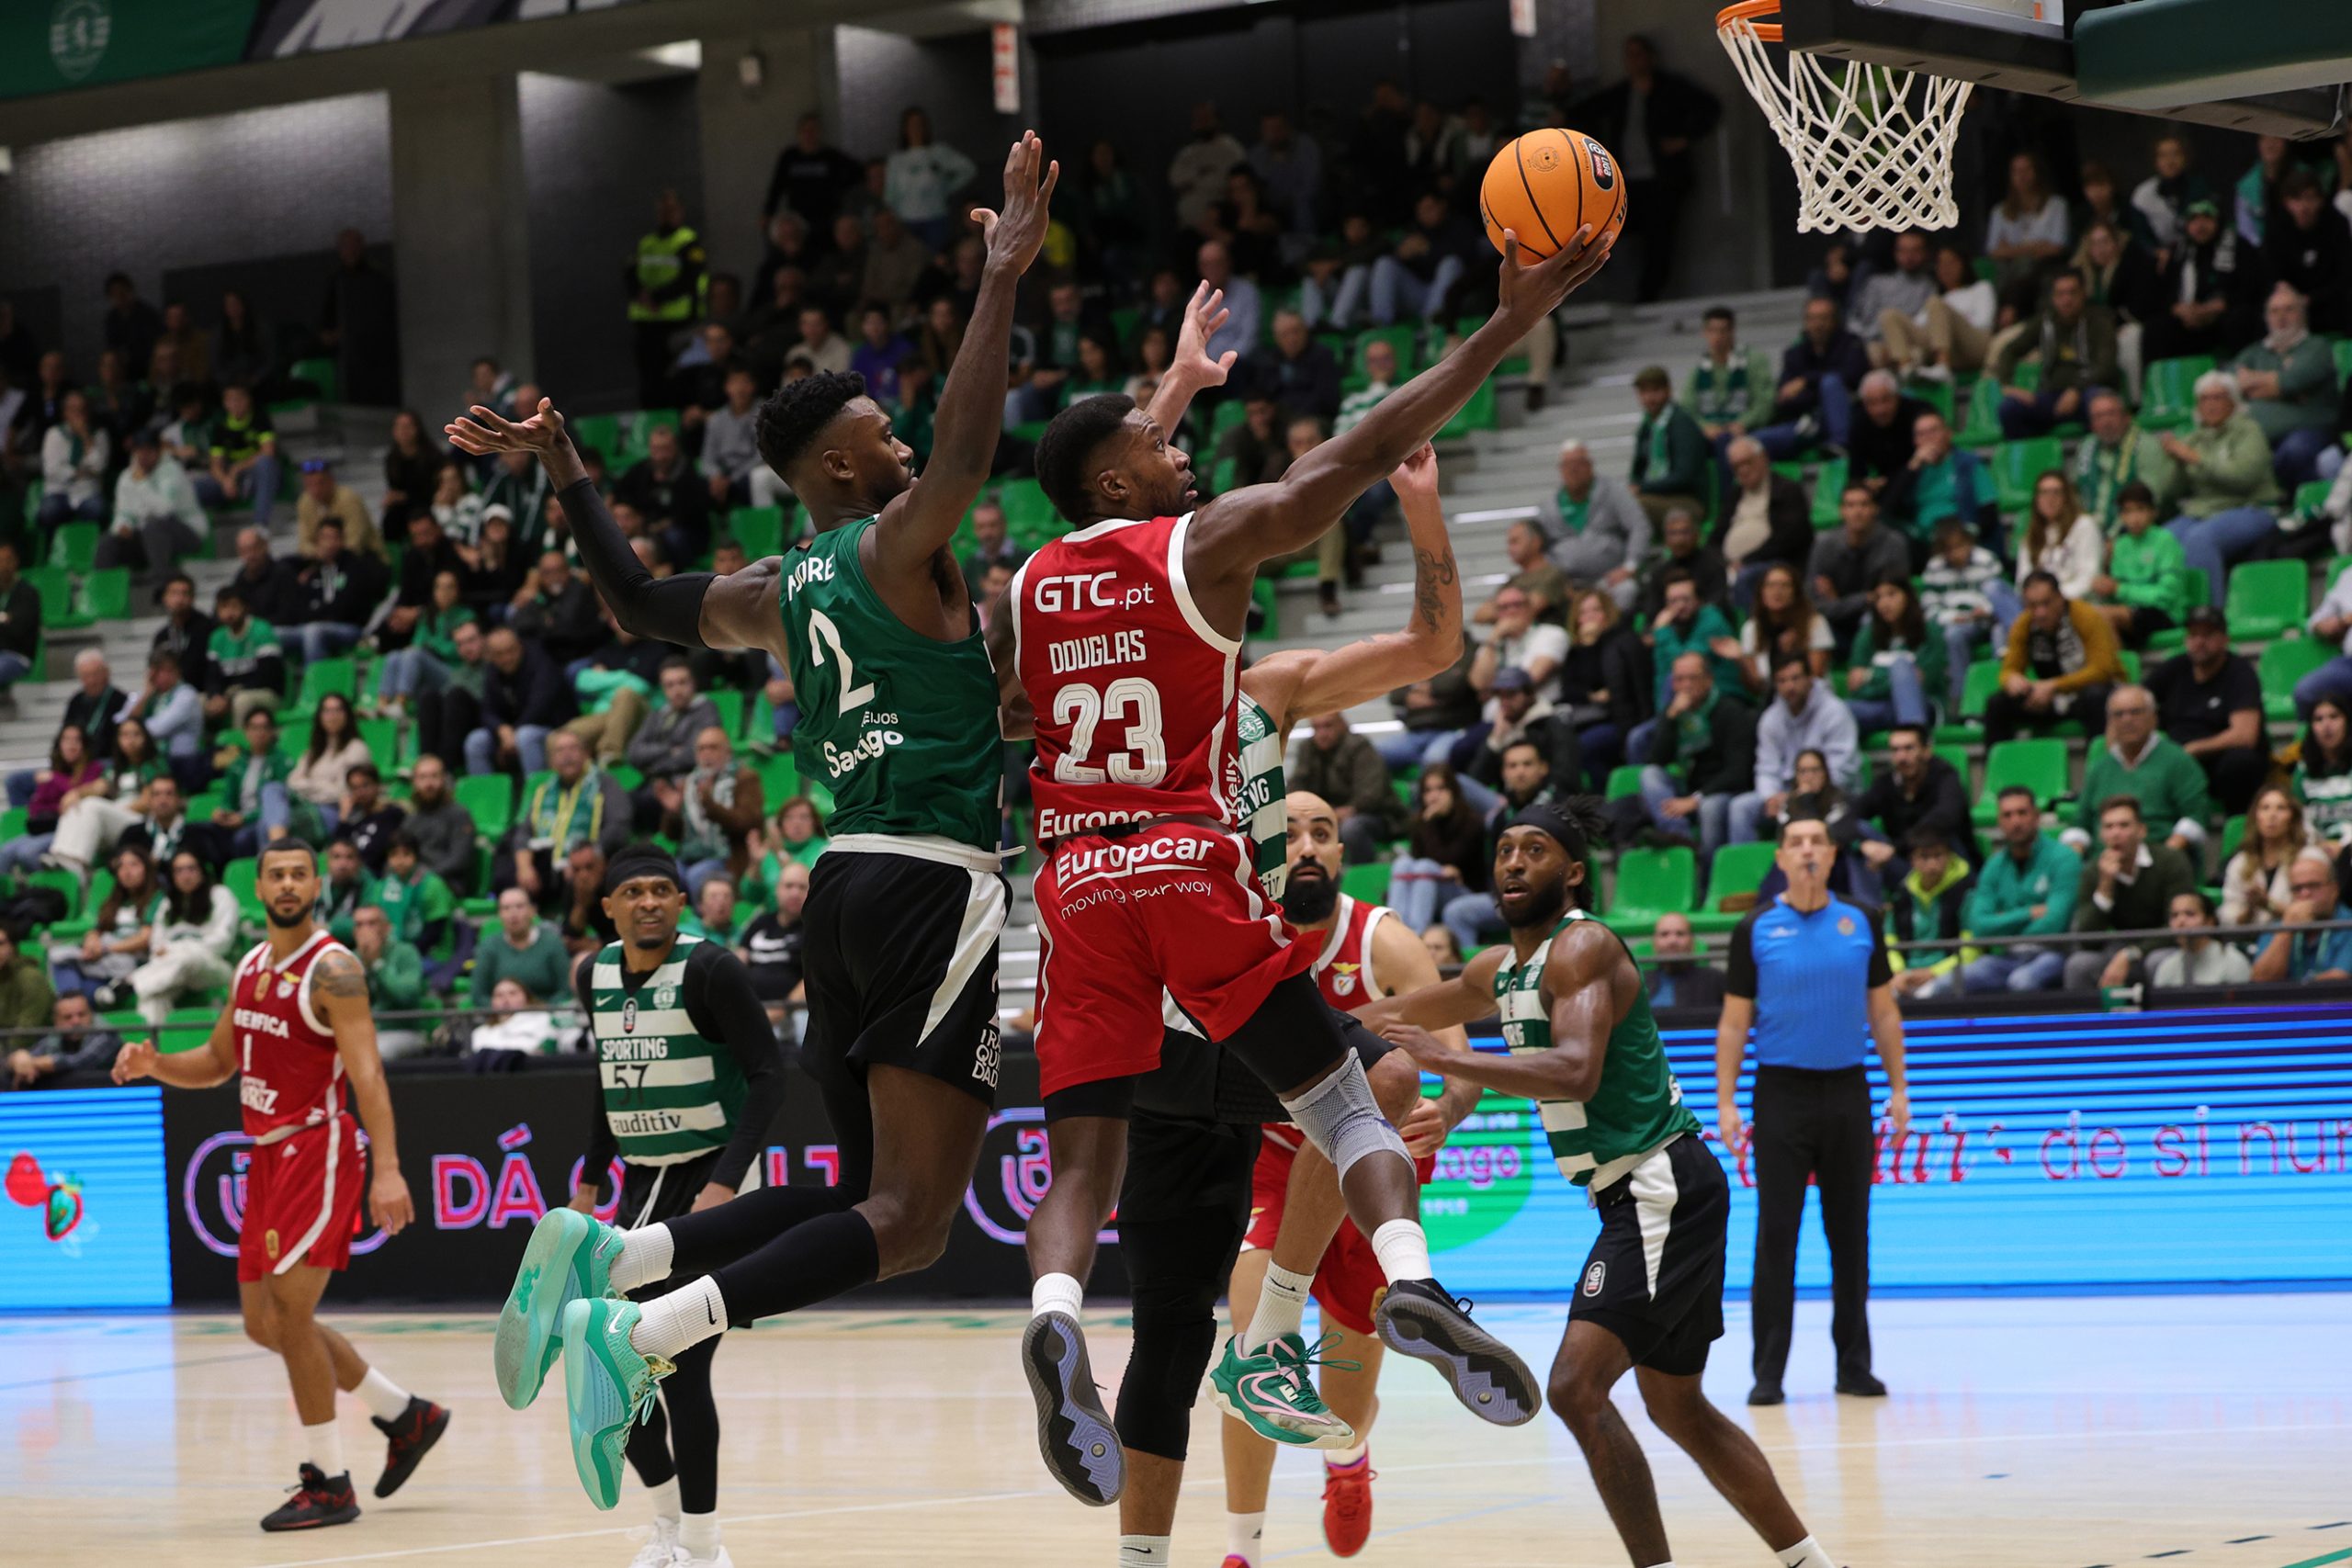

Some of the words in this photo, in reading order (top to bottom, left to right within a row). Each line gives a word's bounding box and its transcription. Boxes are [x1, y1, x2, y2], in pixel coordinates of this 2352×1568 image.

[1035, 571, 1155, 613] GTC.pt
[808, 608, 876, 718] 2
[1048, 629, 1147, 675] DOUGLAS
[1053, 677, 1167, 788] 23
[1057, 837, 1215, 889] Europcar
[1060, 887, 1126, 920] moving
[1129, 884, 1172, 903] your
[1174, 881, 1212, 897] way
[602, 1037, 668, 1061] SPORTING
[614, 1064, 650, 1105] 57
[2041, 1110, 2126, 1179] de
[2154, 1104, 2211, 1177] si
[432, 1122, 548, 1230] DÁ
